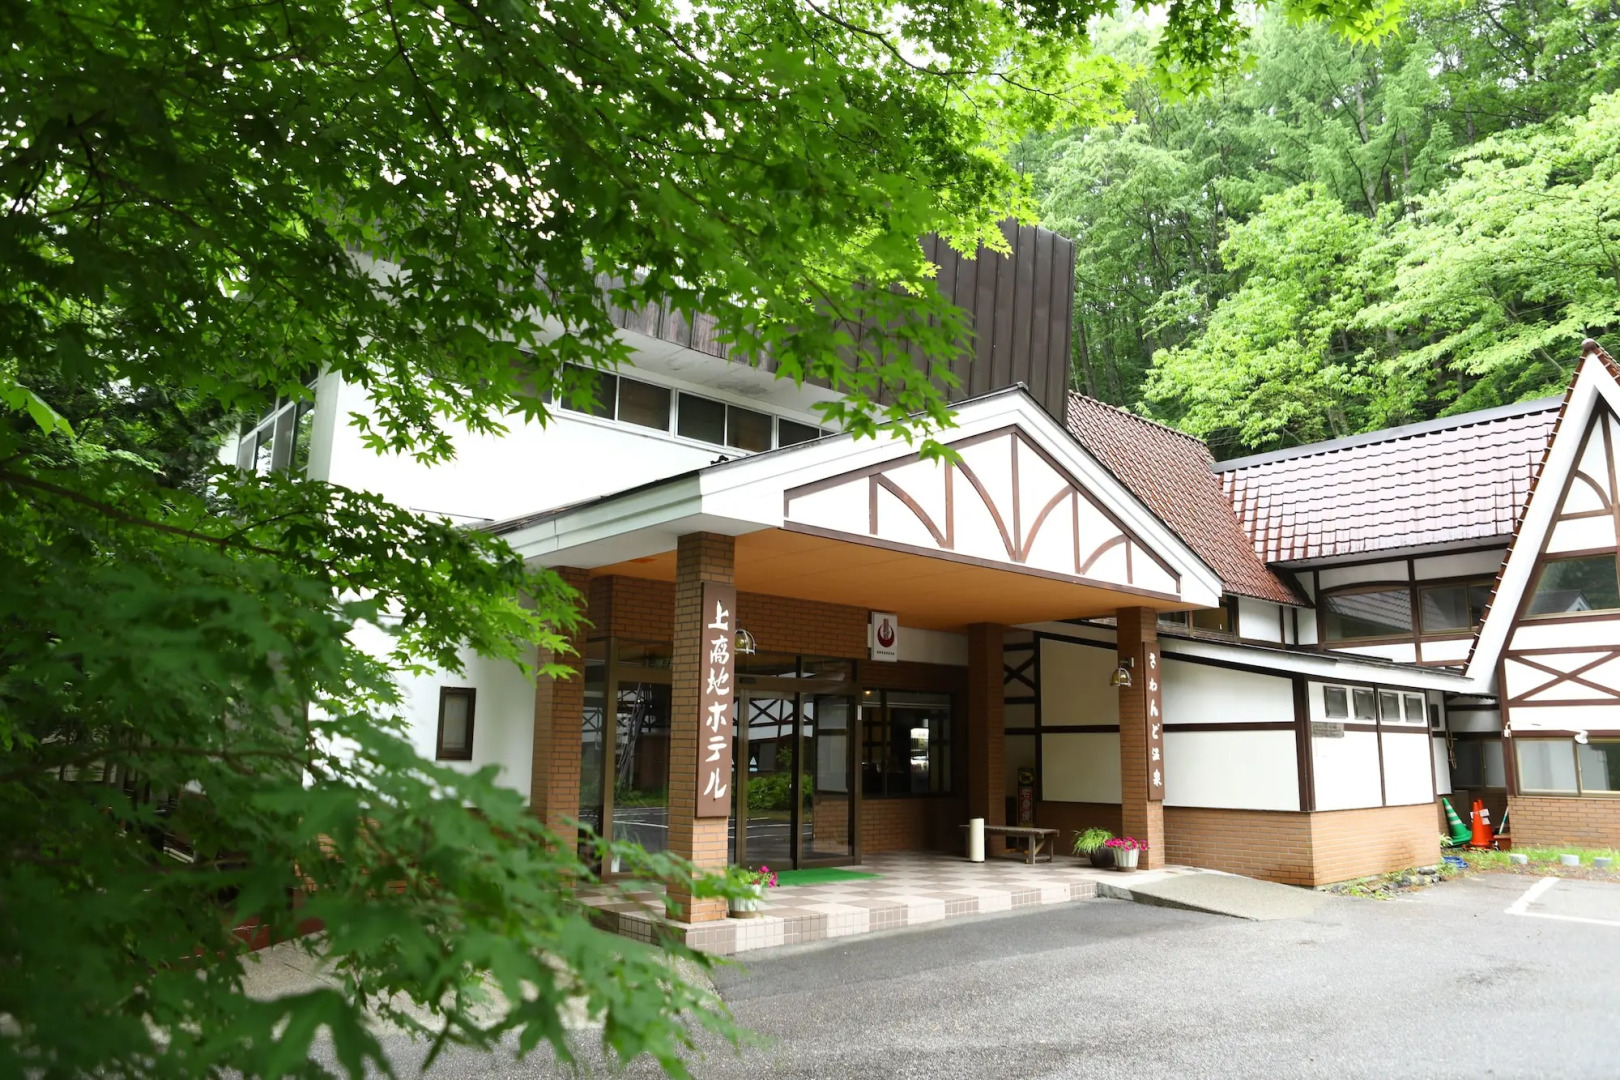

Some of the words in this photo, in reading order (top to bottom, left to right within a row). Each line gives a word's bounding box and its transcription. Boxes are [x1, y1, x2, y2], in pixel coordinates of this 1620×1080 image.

[703, 600, 730, 798] 上高地ホテル
[1149, 652, 1162, 787] さわんど温泉
